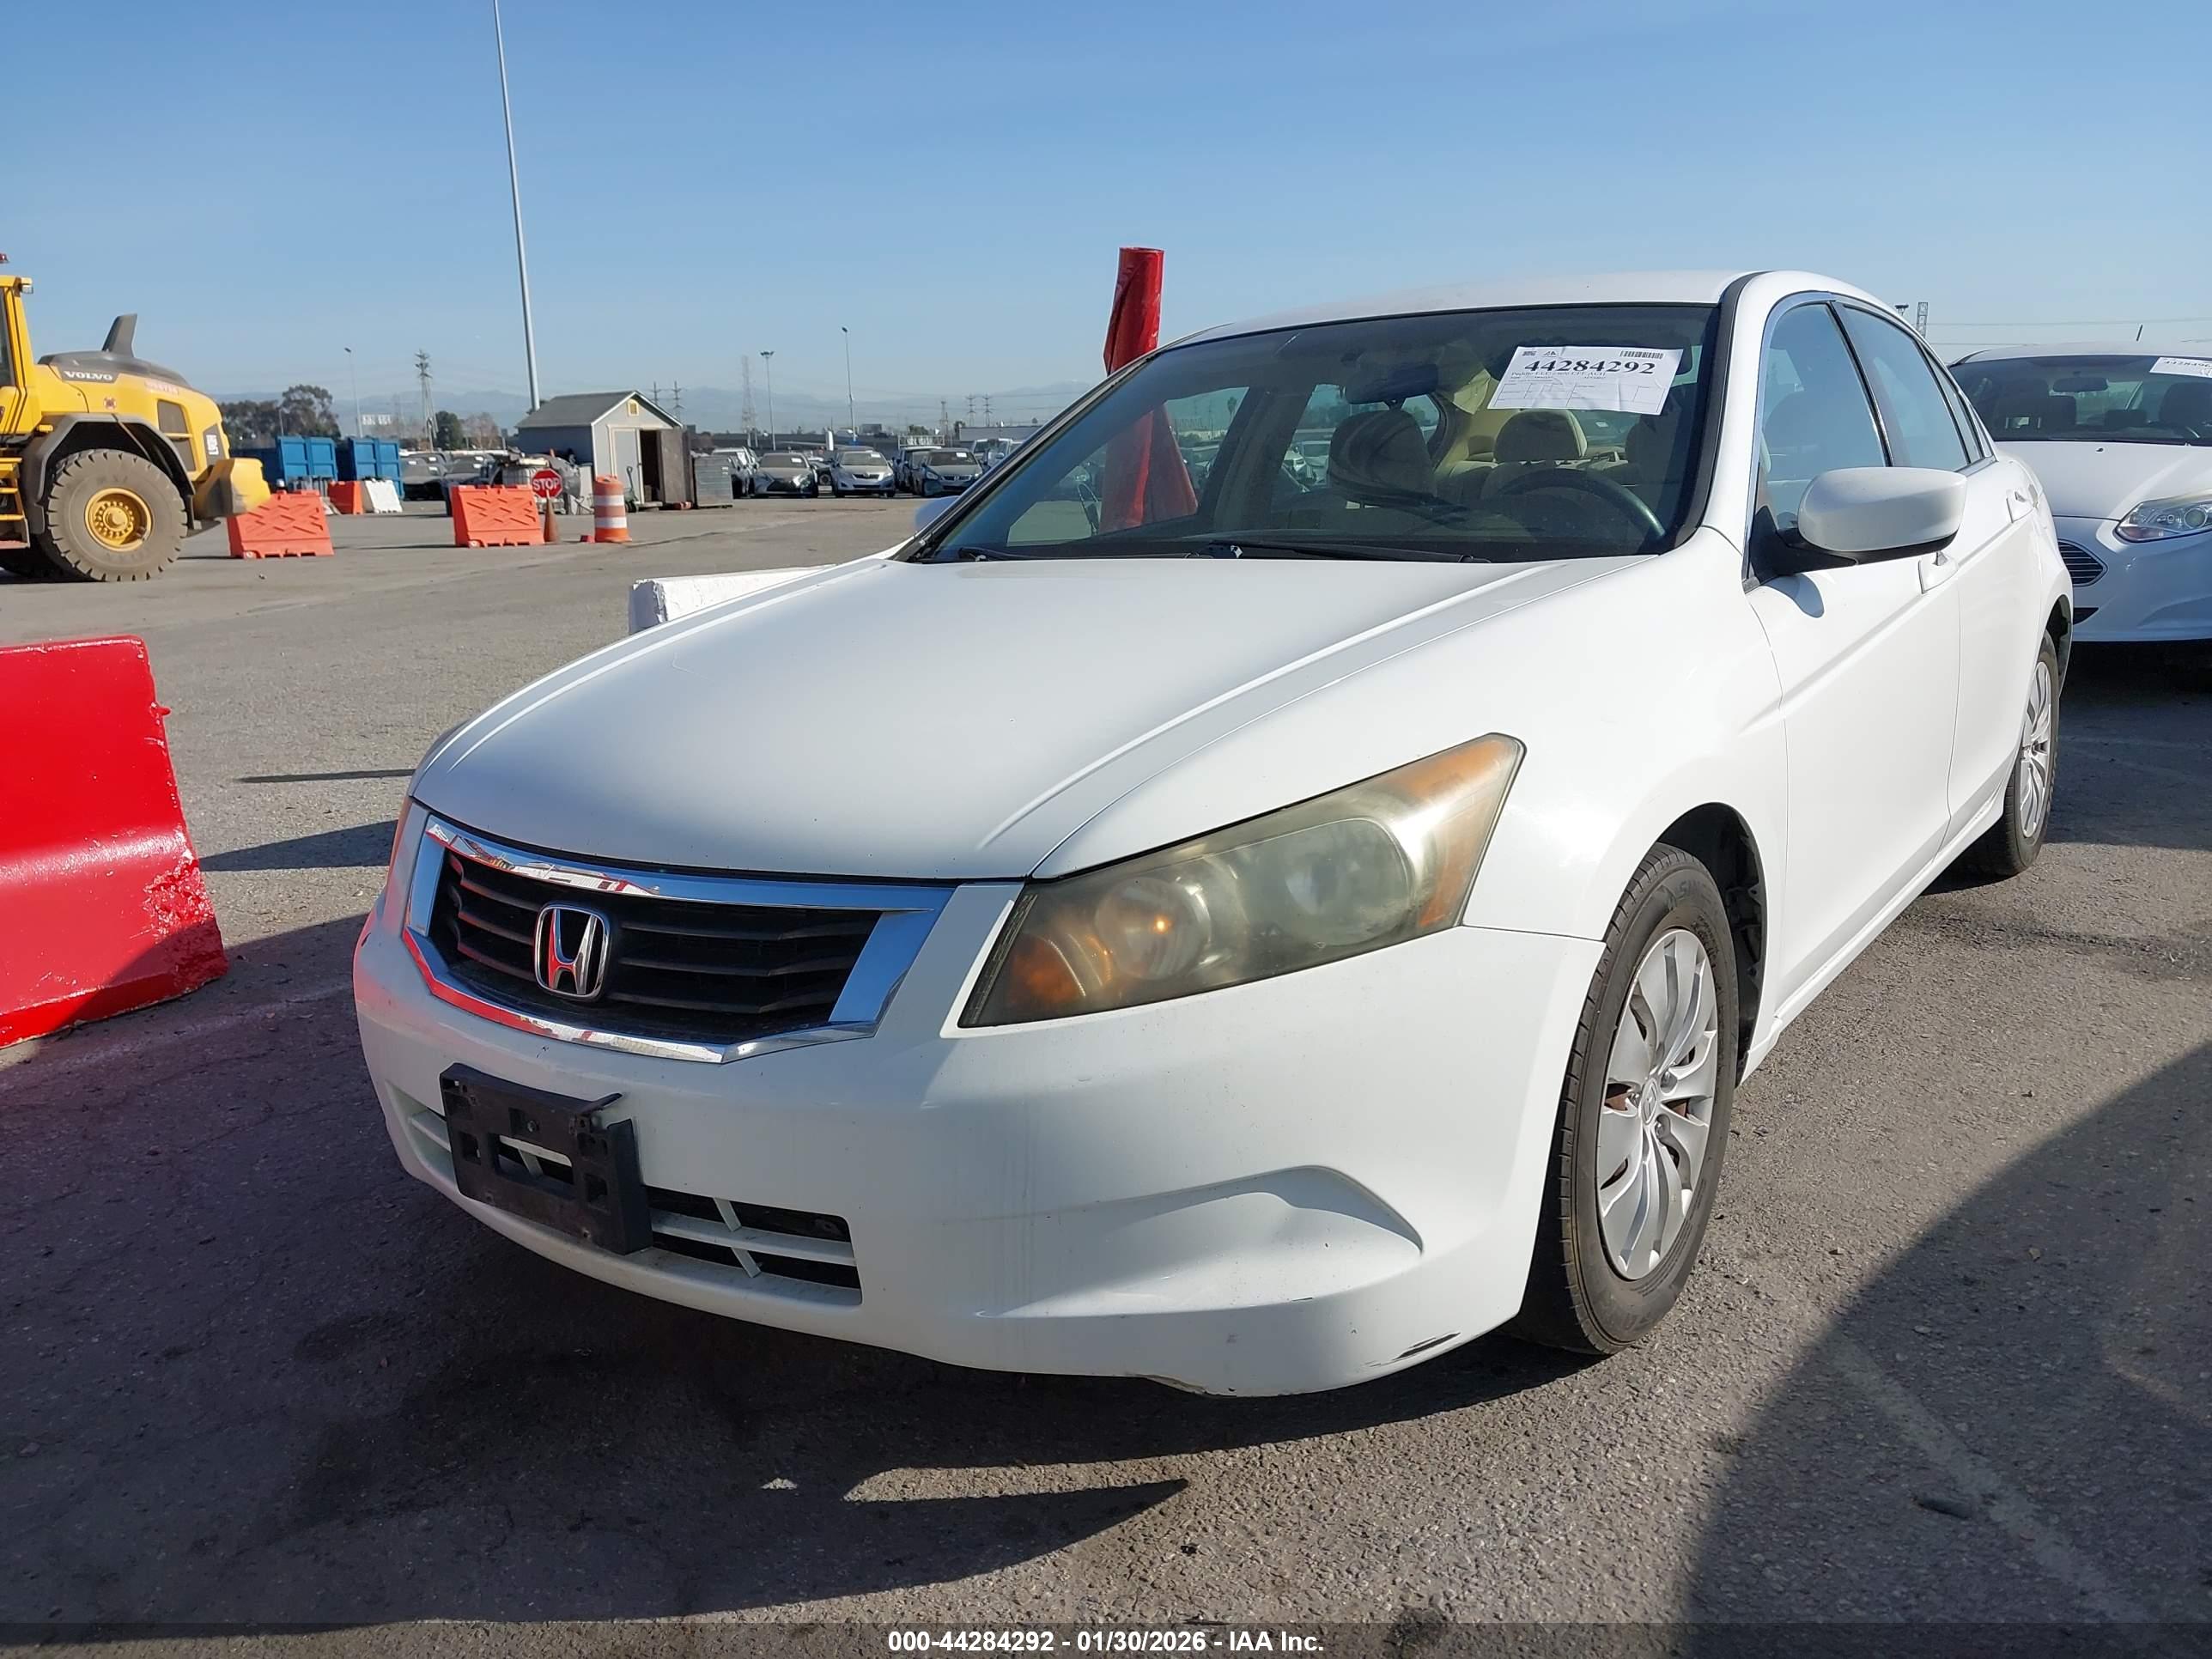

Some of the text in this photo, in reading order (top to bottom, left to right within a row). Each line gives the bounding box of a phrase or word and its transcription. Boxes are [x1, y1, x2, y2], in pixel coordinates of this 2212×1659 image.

[1524, 360, 1656, 374] 44284292
[64, 371, 112, 381] VOLVO
[532, 478, 559, 490] STOP
